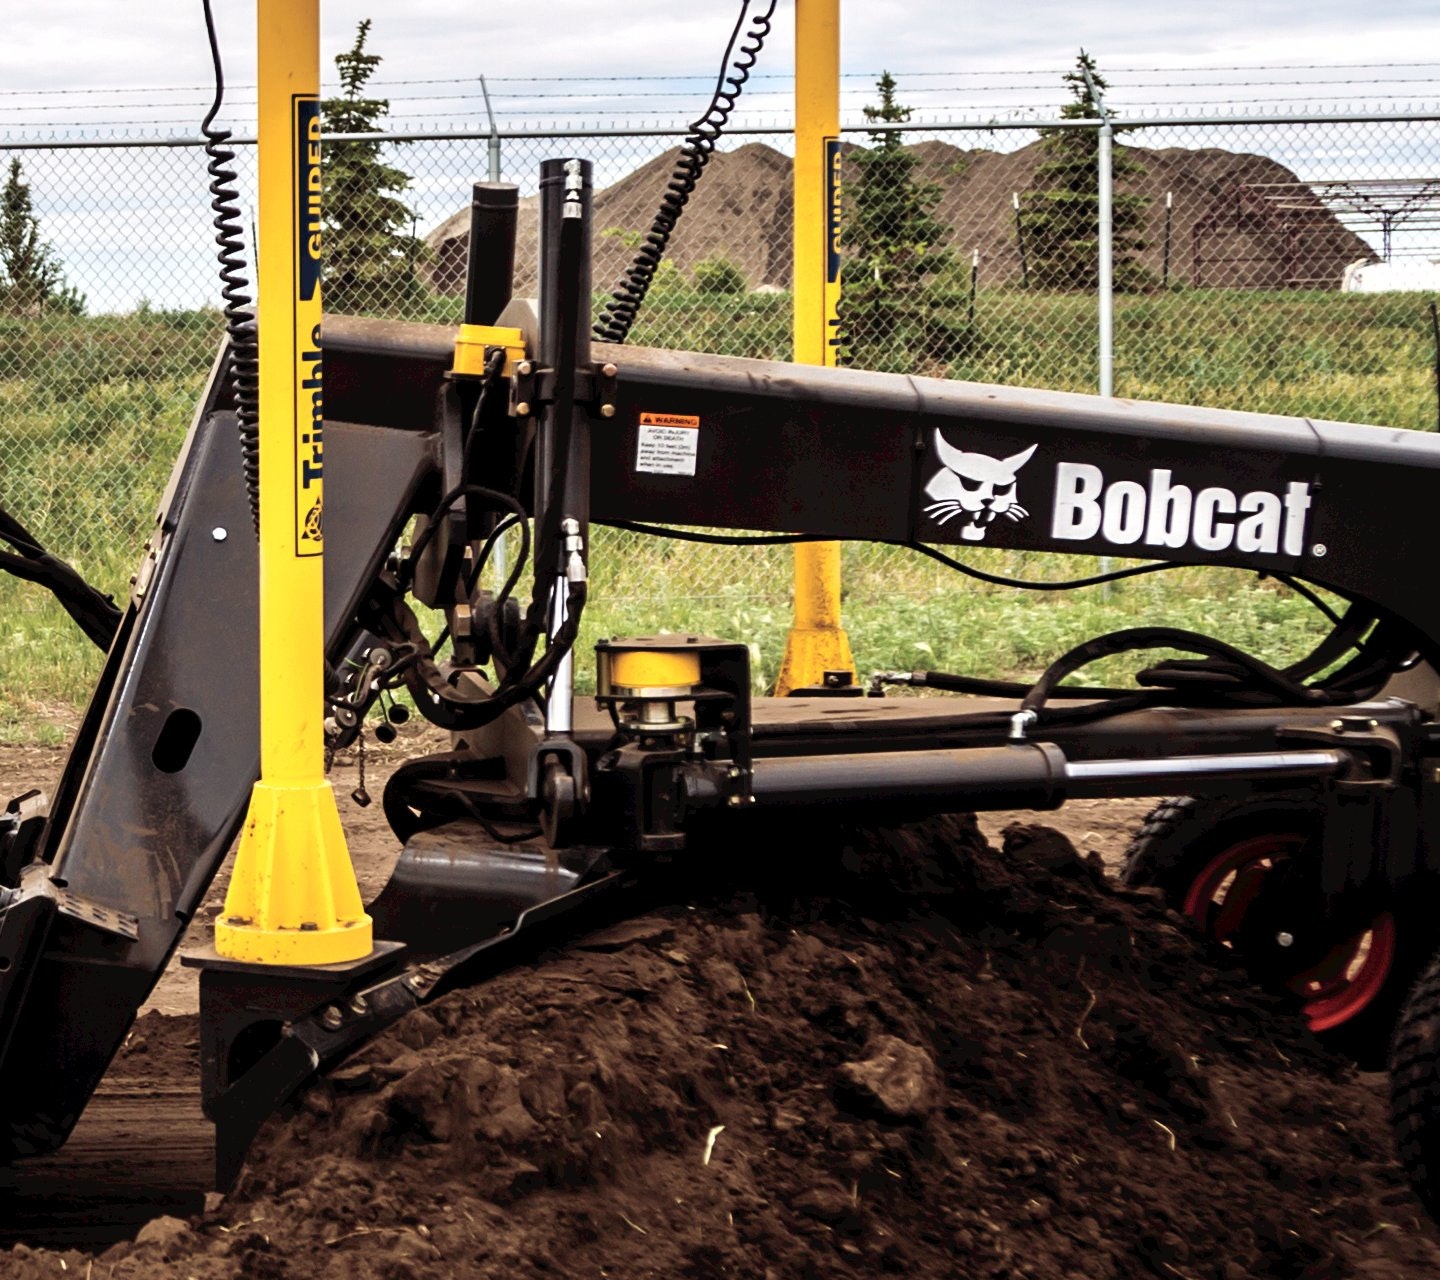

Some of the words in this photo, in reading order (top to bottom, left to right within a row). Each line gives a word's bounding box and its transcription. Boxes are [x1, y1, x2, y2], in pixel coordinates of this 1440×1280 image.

[308, 116, 321, 259] GUIDED
[302, 323, 323, 489] Trimble
[656, 416, 697, 425] WARNING
[1051, 461, 1311, 556] Bobcat
